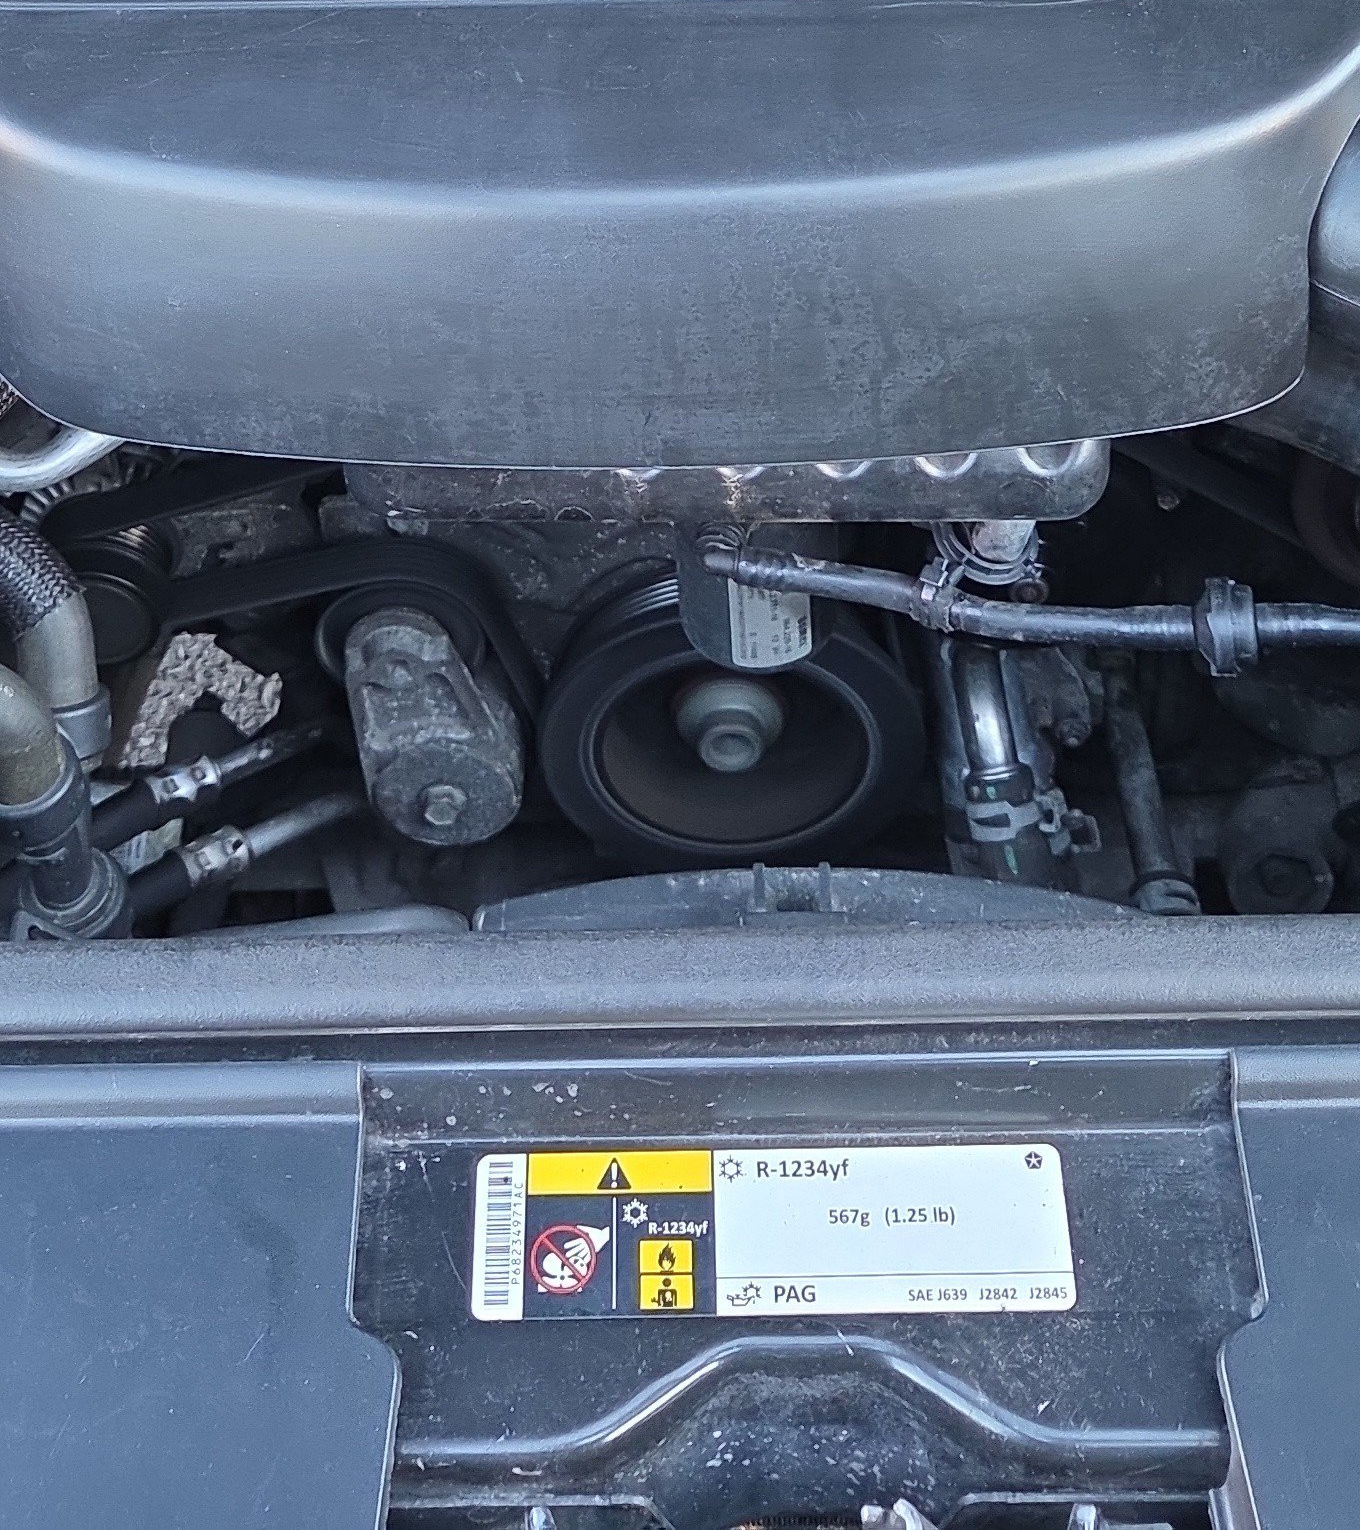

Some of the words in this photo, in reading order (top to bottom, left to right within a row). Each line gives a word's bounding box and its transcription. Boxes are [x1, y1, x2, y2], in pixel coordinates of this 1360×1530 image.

[757, 1158, 849, 1181] R-1234yf
[829, 1209, 870, 1227] 567g
[884, 1207, 928, 1227] (1.25
[933, 1206, 955, 1226] lb)
[511, 1182, 524, 1285] P68234971AC
[648, 1220, 709, 1235] R-1234yf
[774, 1284, 816, 1303] PAG
[908, 1288, 933, 1301] SAE
[937, 1288, 968, 1301] J639
[979, 1287, 1018, 1300] J2842
[1029, 1286, 1068, 1300] J2845
